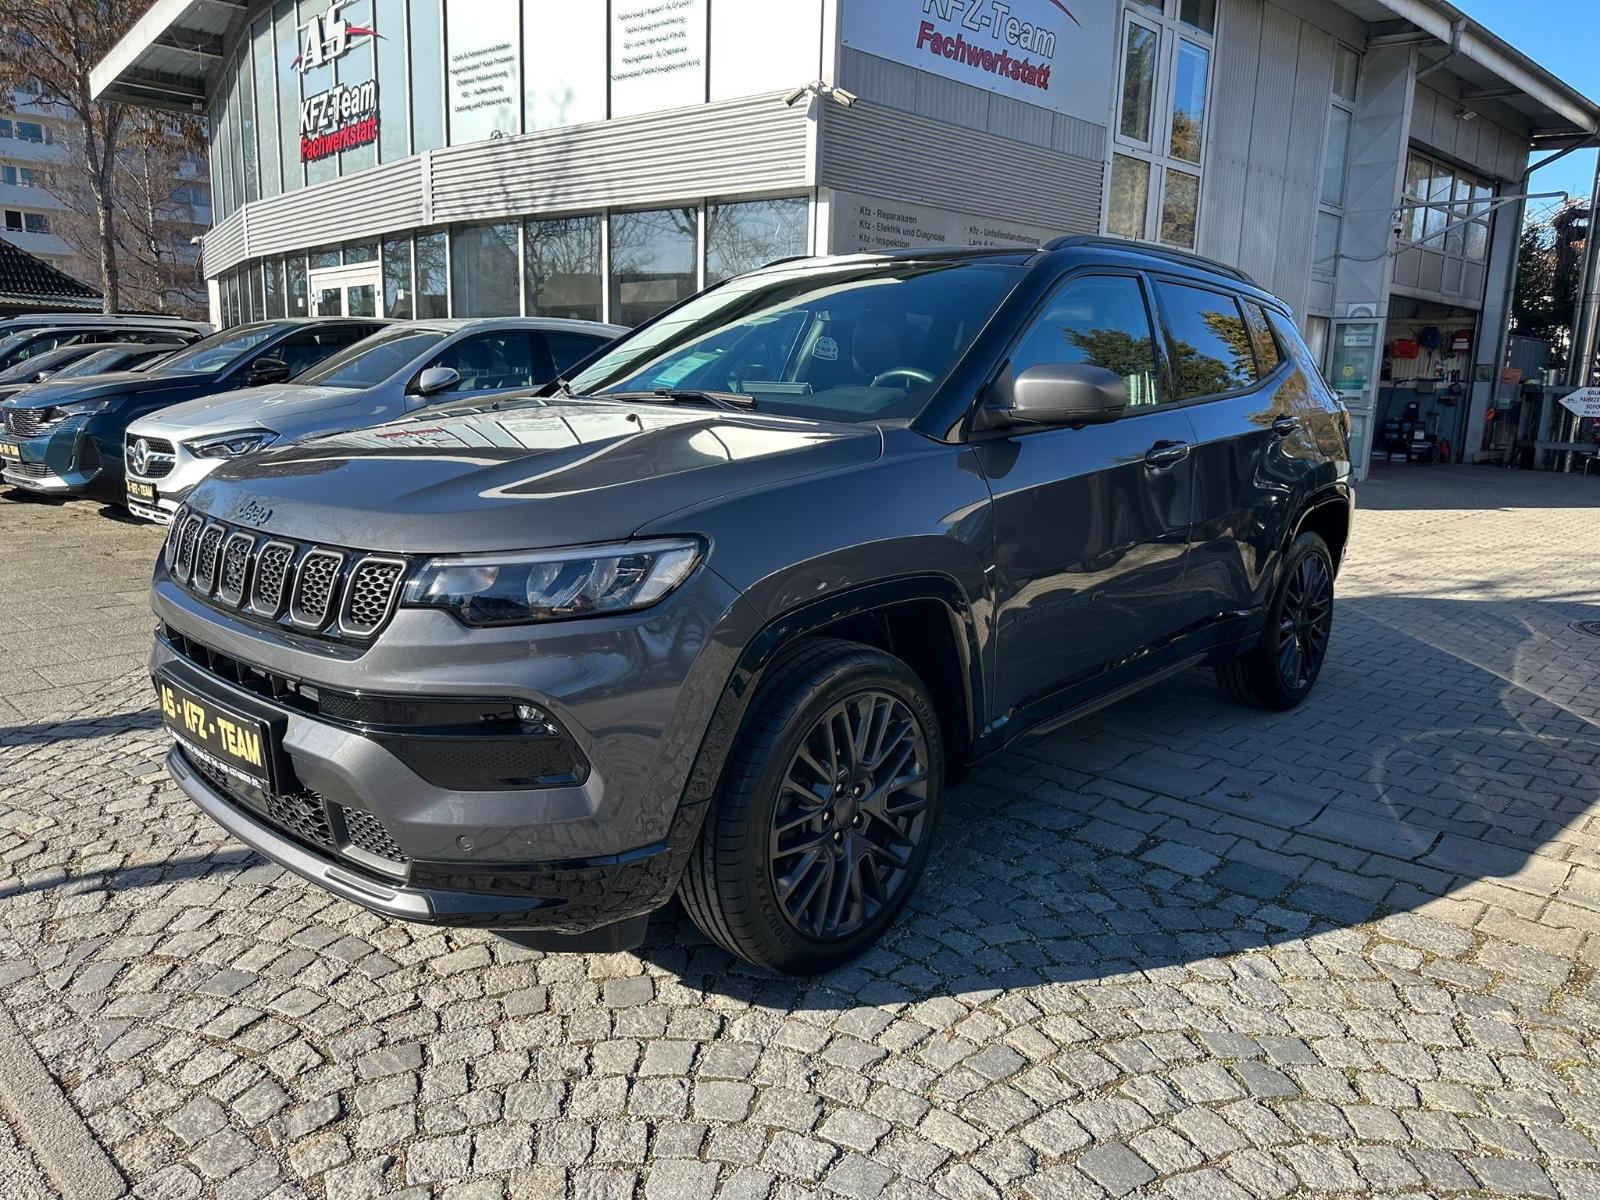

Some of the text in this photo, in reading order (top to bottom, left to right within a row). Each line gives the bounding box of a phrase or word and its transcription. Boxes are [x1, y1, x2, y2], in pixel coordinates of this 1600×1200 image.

[916, 20, 1051, 90] Fachwerkstatt
[300, 80, 377, 134] KFZ-Team
[301, 114, 378, 163] Fachwerkstatt
[860, 206, 871, 216] Kfz
[877, 209, 917, 224] Reparaturen
[860, 219, 871, 230] Kfz
[902, 228, 915, 236] und
[916, 229, 945, 241] Diagnose
[859, 233, 870, 243] Kfz
[876, 235, 910, 248] Inspektion
[239, 500, 273, 527] Jeep
[161, 684, 176, 719] AS
[183, 698, 208, 740] KFZ
[217, 716, 262, 767] TEAM
